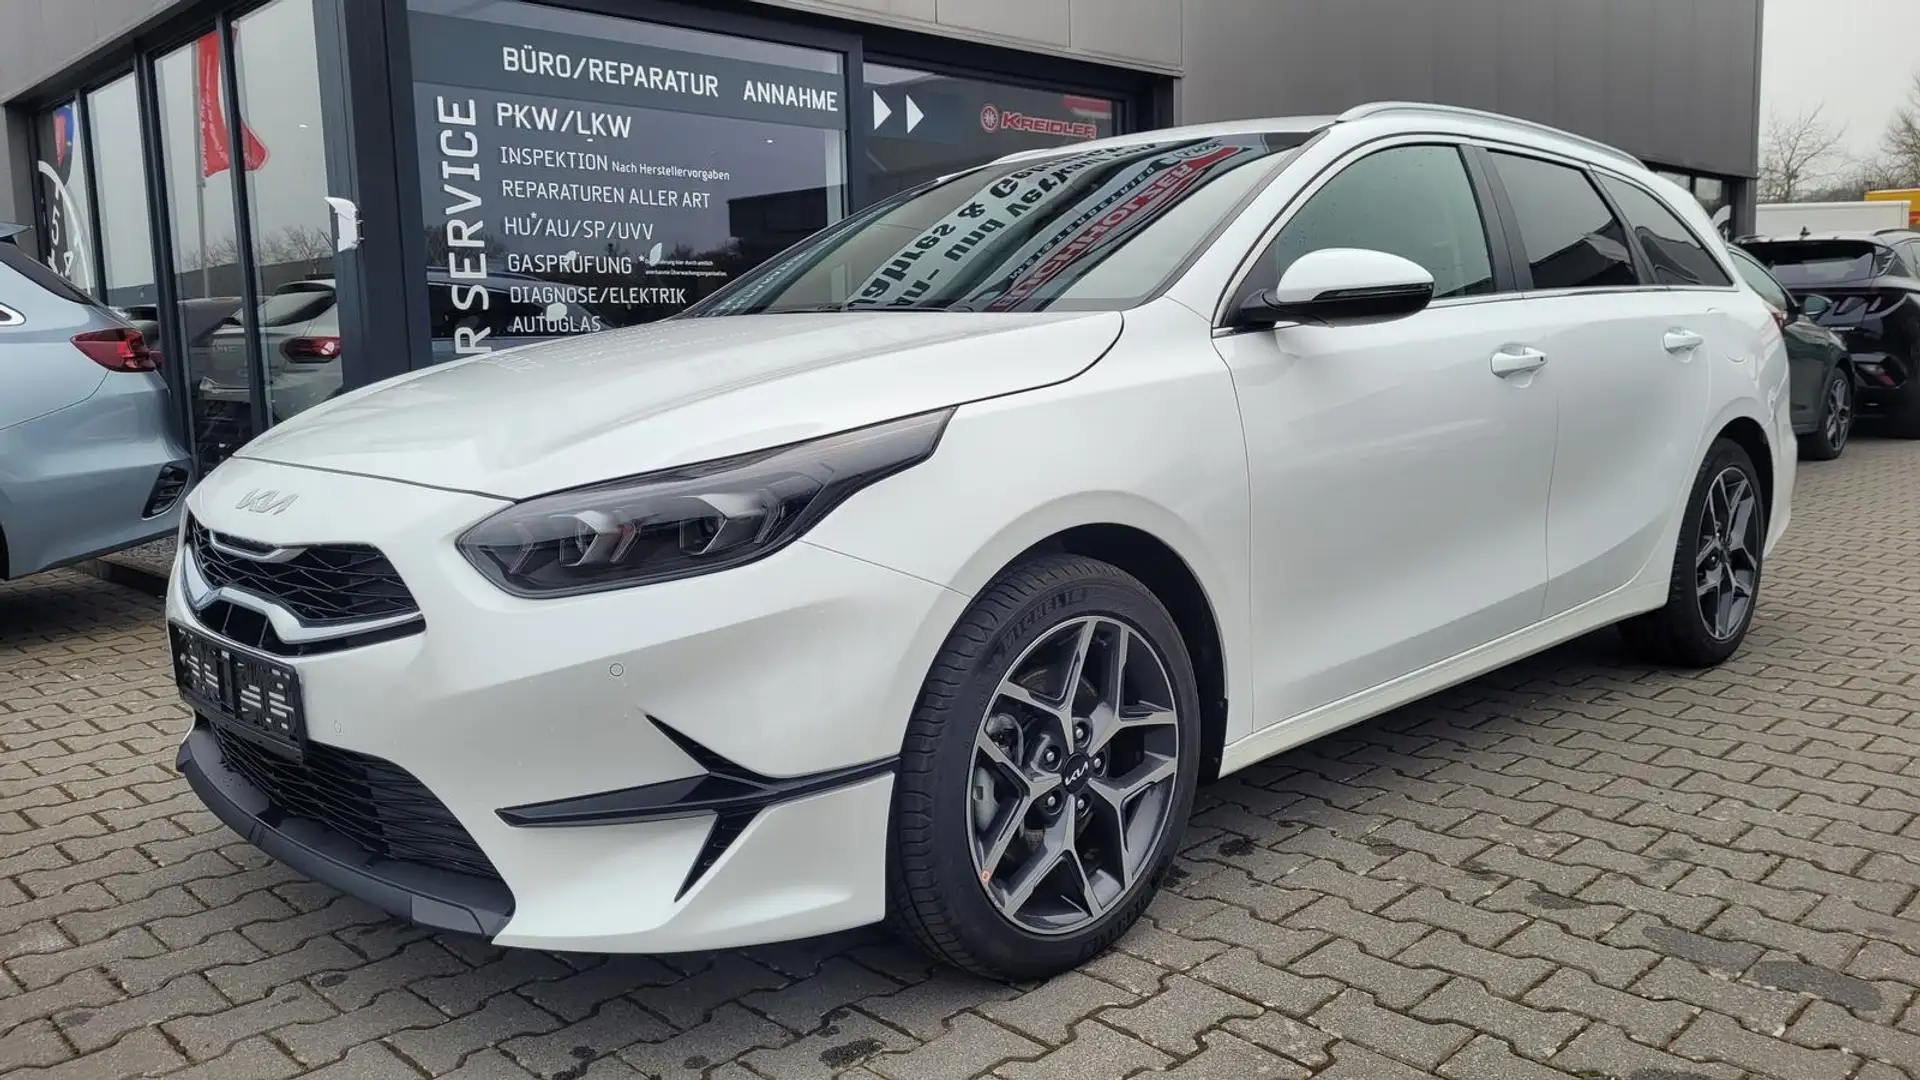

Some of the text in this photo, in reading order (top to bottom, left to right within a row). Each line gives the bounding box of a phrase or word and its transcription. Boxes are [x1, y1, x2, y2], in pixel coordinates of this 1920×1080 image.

[502, 45, 838, 113] BÜRO/REPARATUR ANNAHME
[496, 102, 632, 138] PKW/LKW
[1001, 110, 1097, 140] KREIDLER
[500, 146, 730, 182] INSPEKTION Nach Herstellervorgaben
[436, 95, 489, 311] SERVICE
[501, 179, 711, 209] REPARATUREN ALLER ART
[507, 251, 632, 275] GASPRÜFUNG
[510, 286, 687, 305] DIAGNOSE/ELEKTRIK
[513, 315, 602, 334] AUTOGLAS
